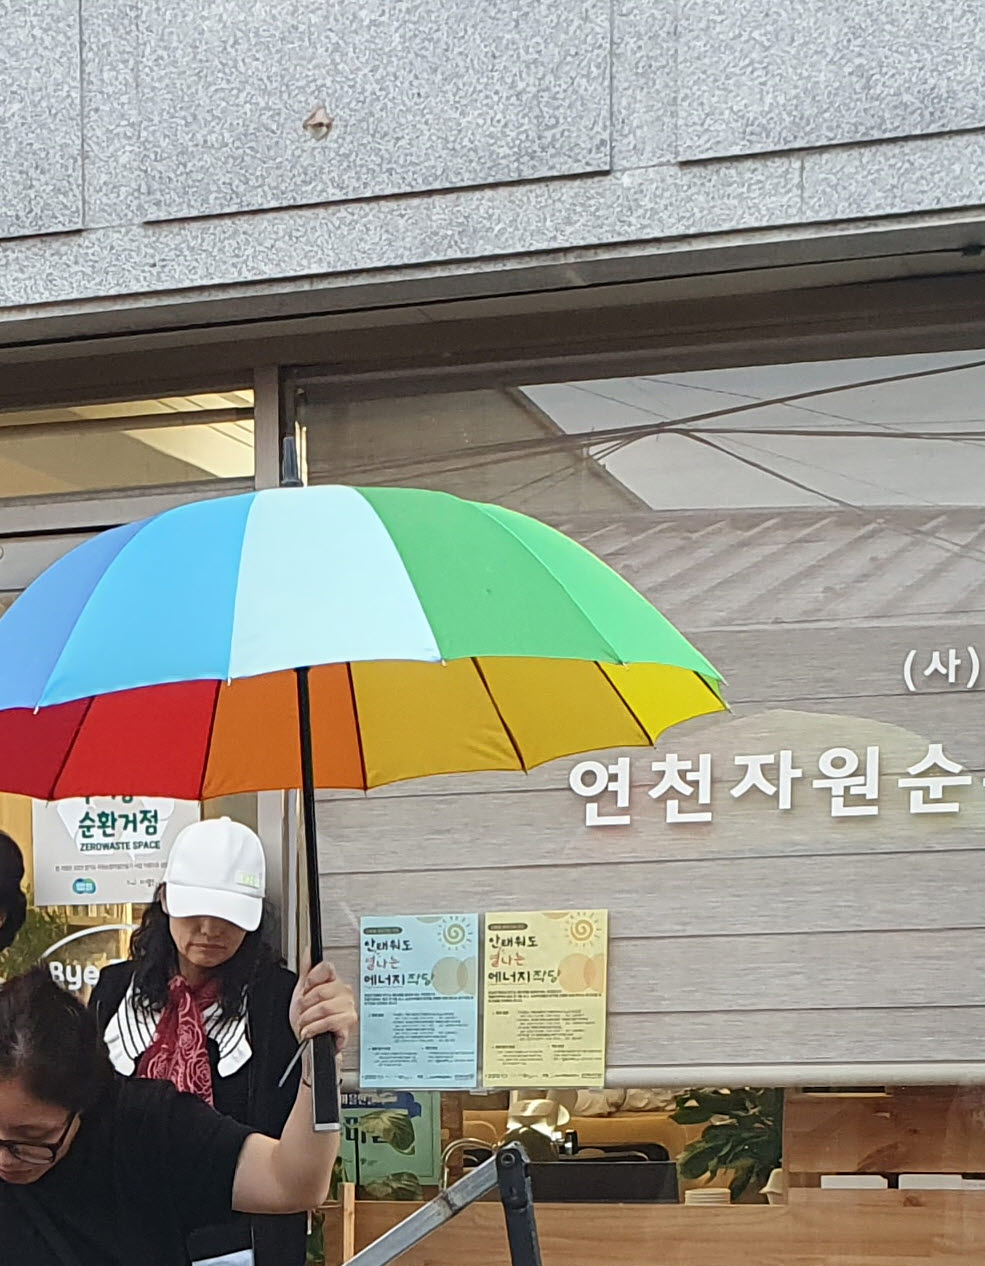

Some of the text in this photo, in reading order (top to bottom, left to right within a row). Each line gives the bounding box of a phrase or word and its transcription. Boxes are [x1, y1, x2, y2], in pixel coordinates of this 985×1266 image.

[903, 646, 982, 692] (사)
[569, 743, 985, 827] 연천자원순
[79, 809, 159, 839] 순환거점
[80, 840, 161, 852] ZEROWASTE SPACE
[49, 961, 100, 991] Bye
